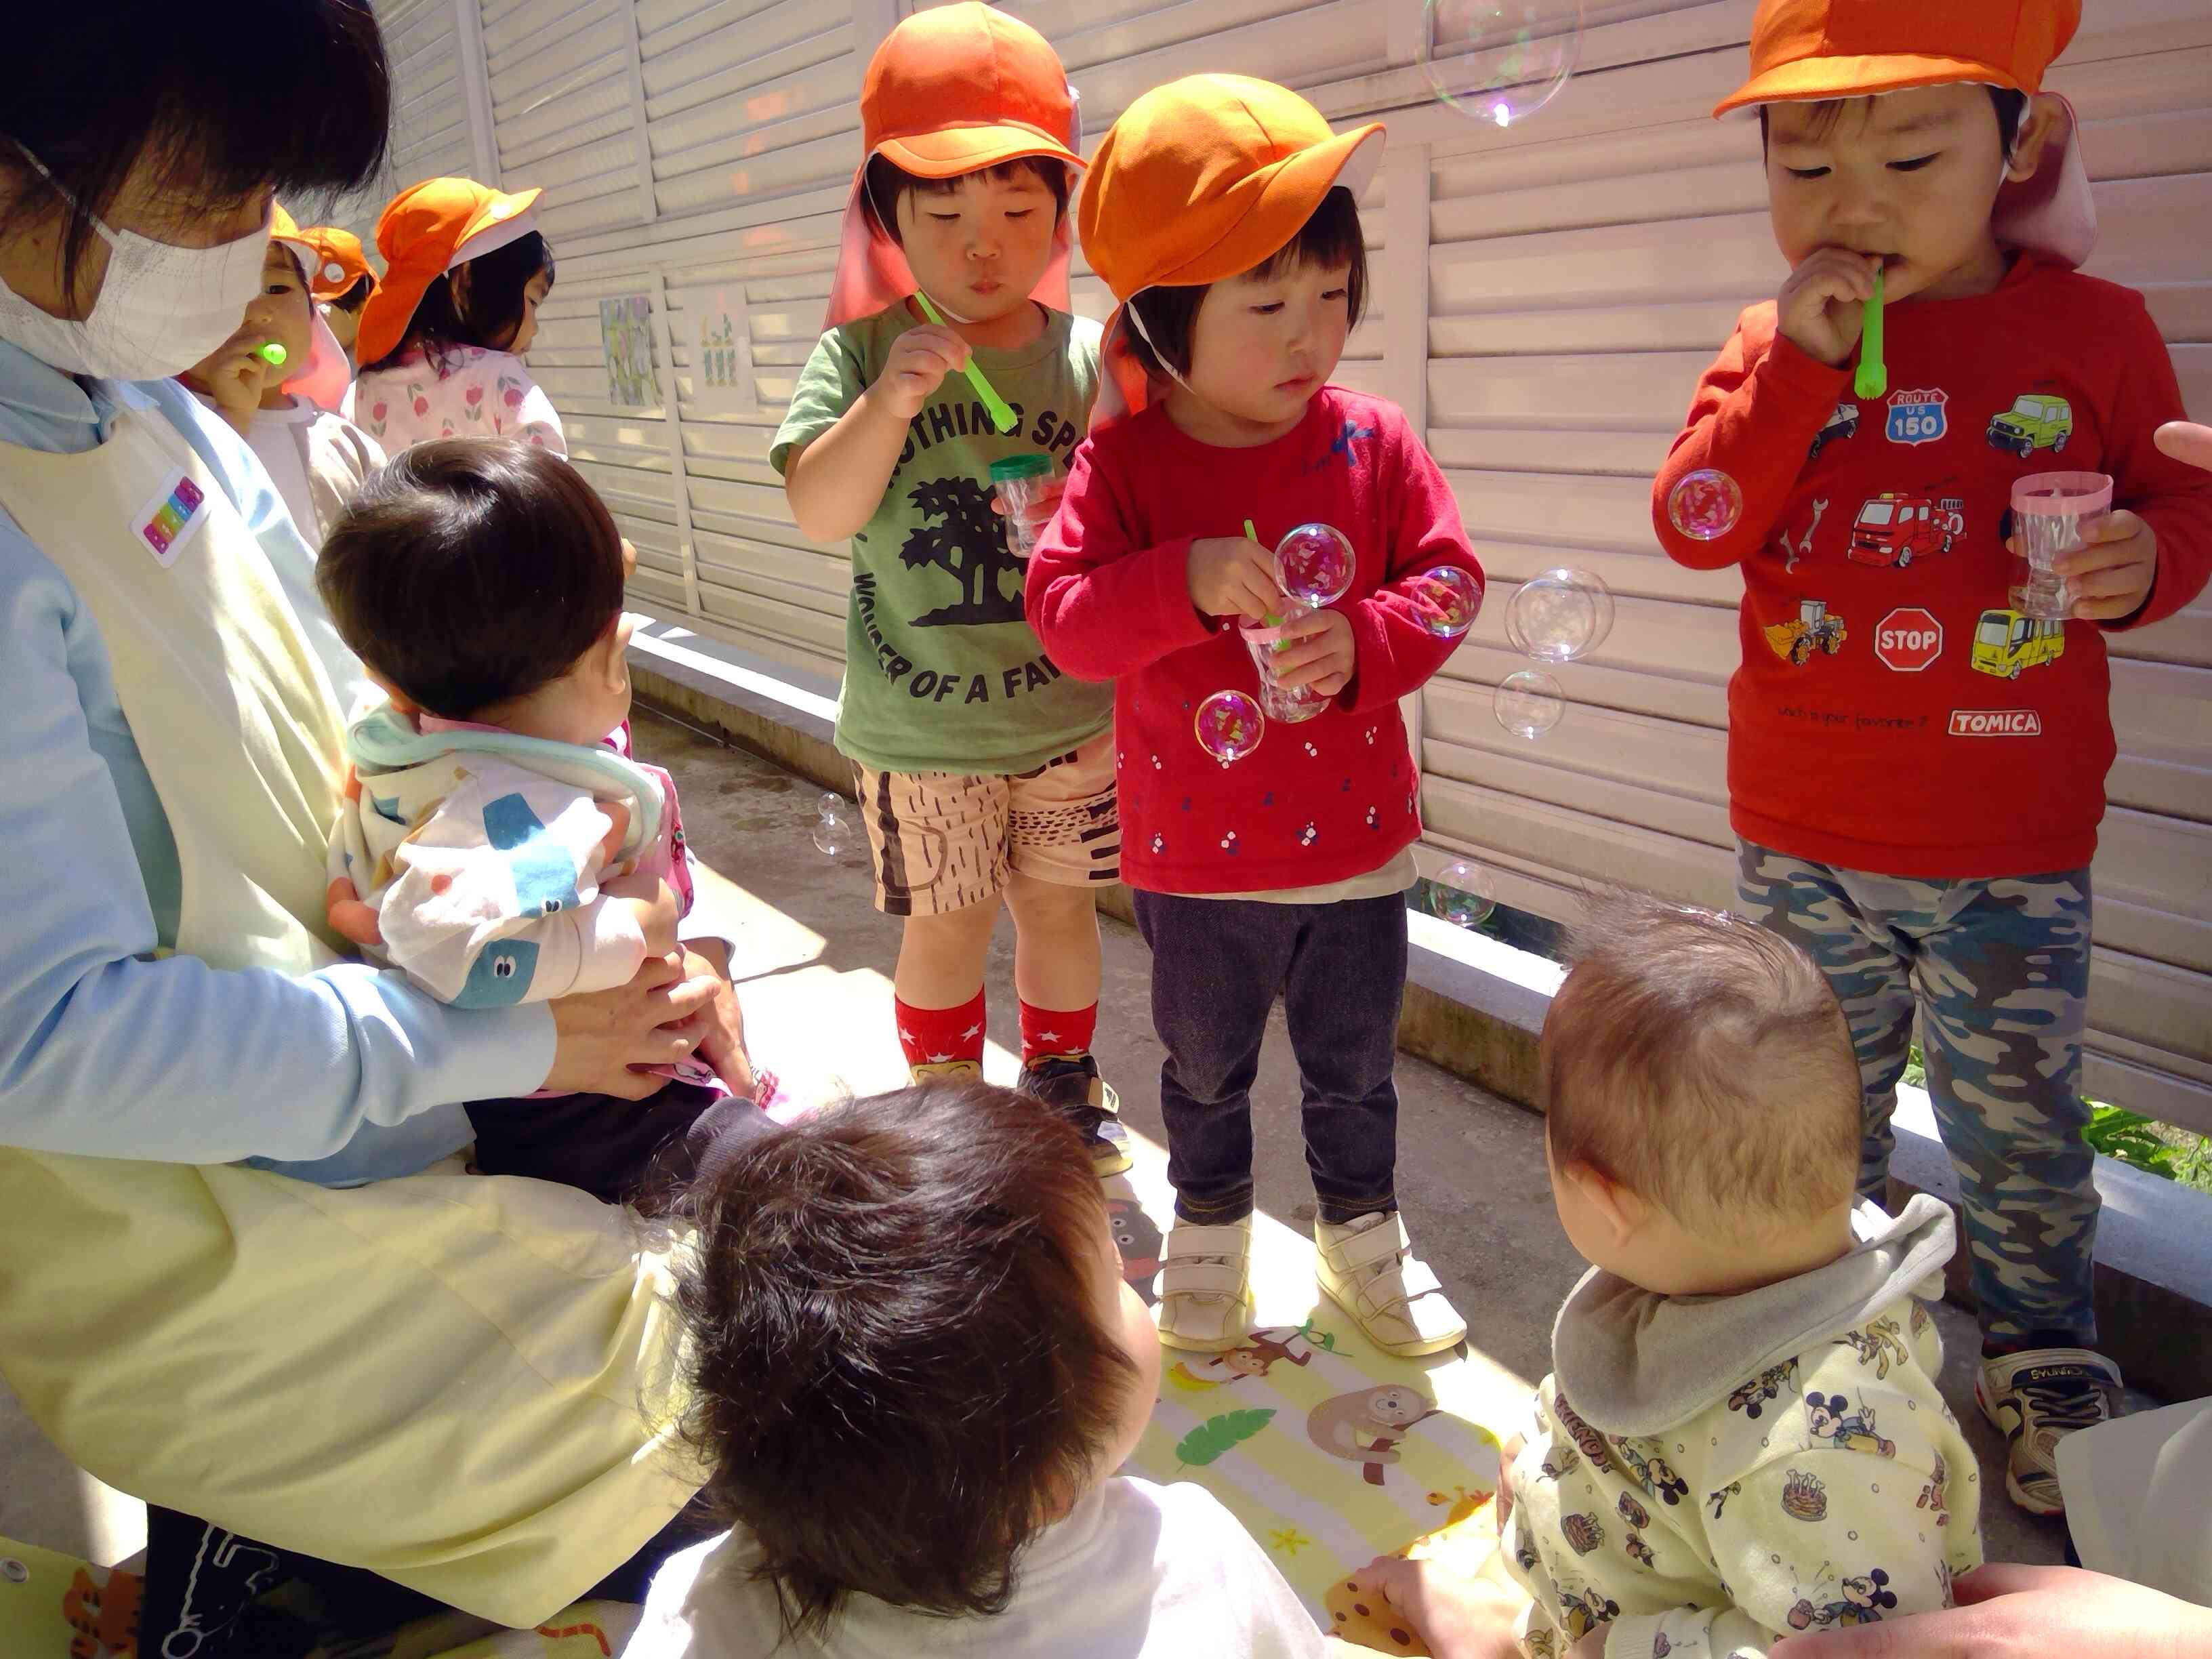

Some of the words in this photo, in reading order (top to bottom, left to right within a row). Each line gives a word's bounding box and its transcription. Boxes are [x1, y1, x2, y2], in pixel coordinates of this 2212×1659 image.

[1897, 393, 1938, 405] ROUTE
[1895, 415, 1938, 436] 150
[887, 401, 1025, 489] OTHING
[1881, 630, 1937, 651] STOP
[909, 670, 961, 703] OF
[964, 674, 989, 705] A
[1002, 654, 1062, 699] FAI
[1957, 714, 2038, 733] TOMICA
